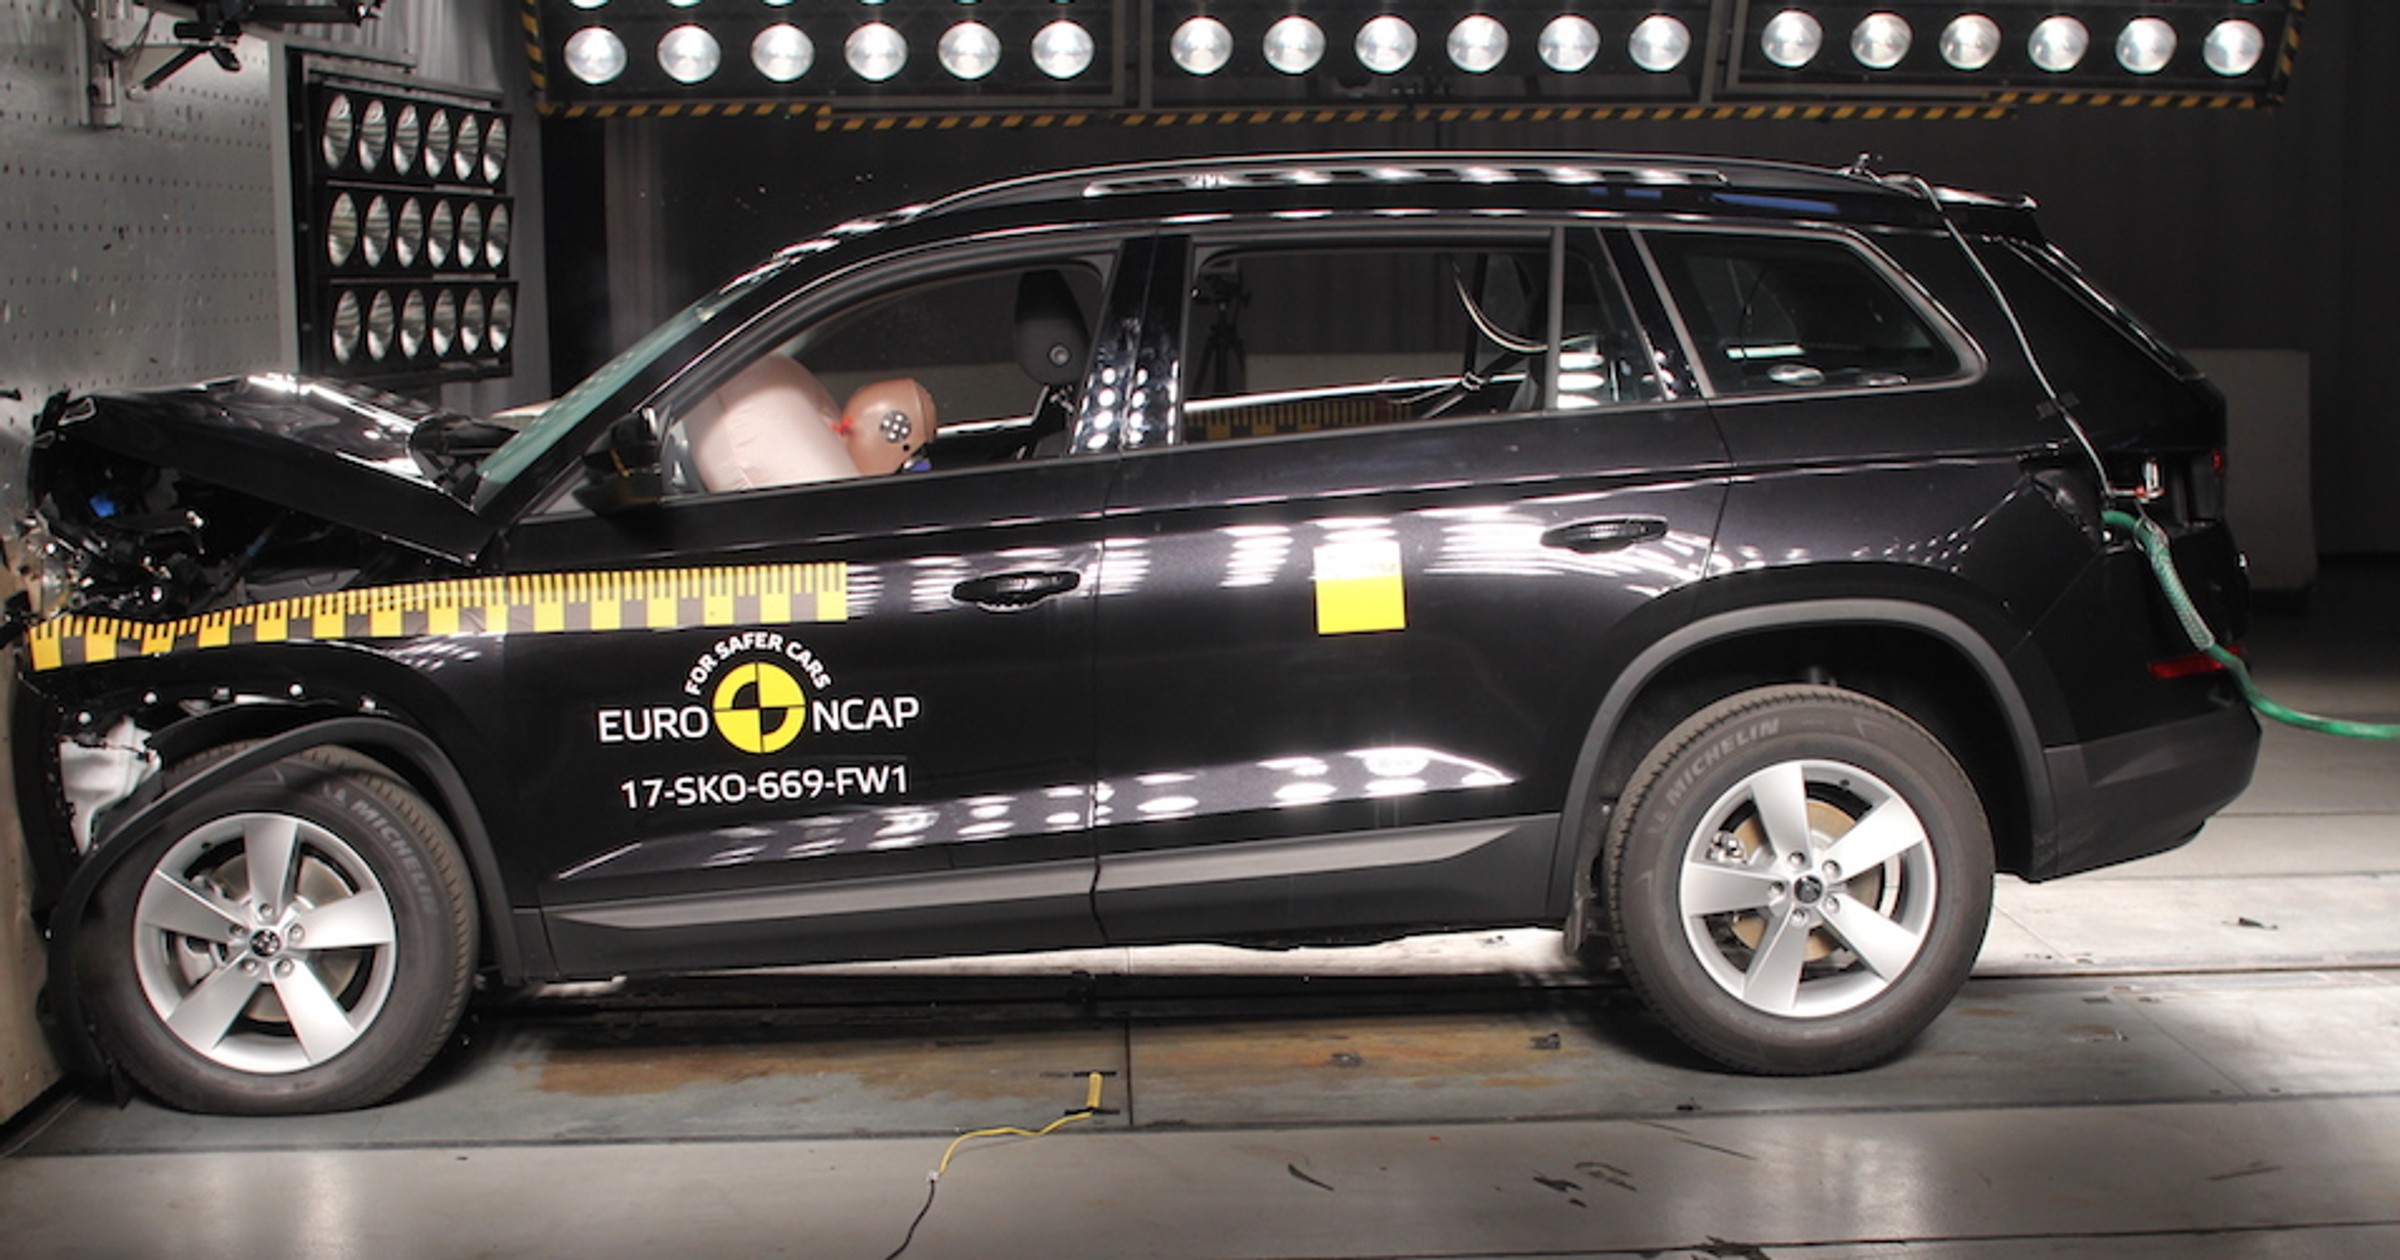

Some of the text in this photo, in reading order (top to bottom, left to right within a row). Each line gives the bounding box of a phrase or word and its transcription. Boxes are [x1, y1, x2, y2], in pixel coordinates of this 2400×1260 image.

[684, 631, 832, 695] FOR SAFER CARS
[598, 696, 919, 742] EURO NCAP
[621, 765, 908, 808] 17-SKO-669-FW1
[1665, 718, 1781, 806] MICHELIN
[351, 800, 440, 914] MICHELIN
